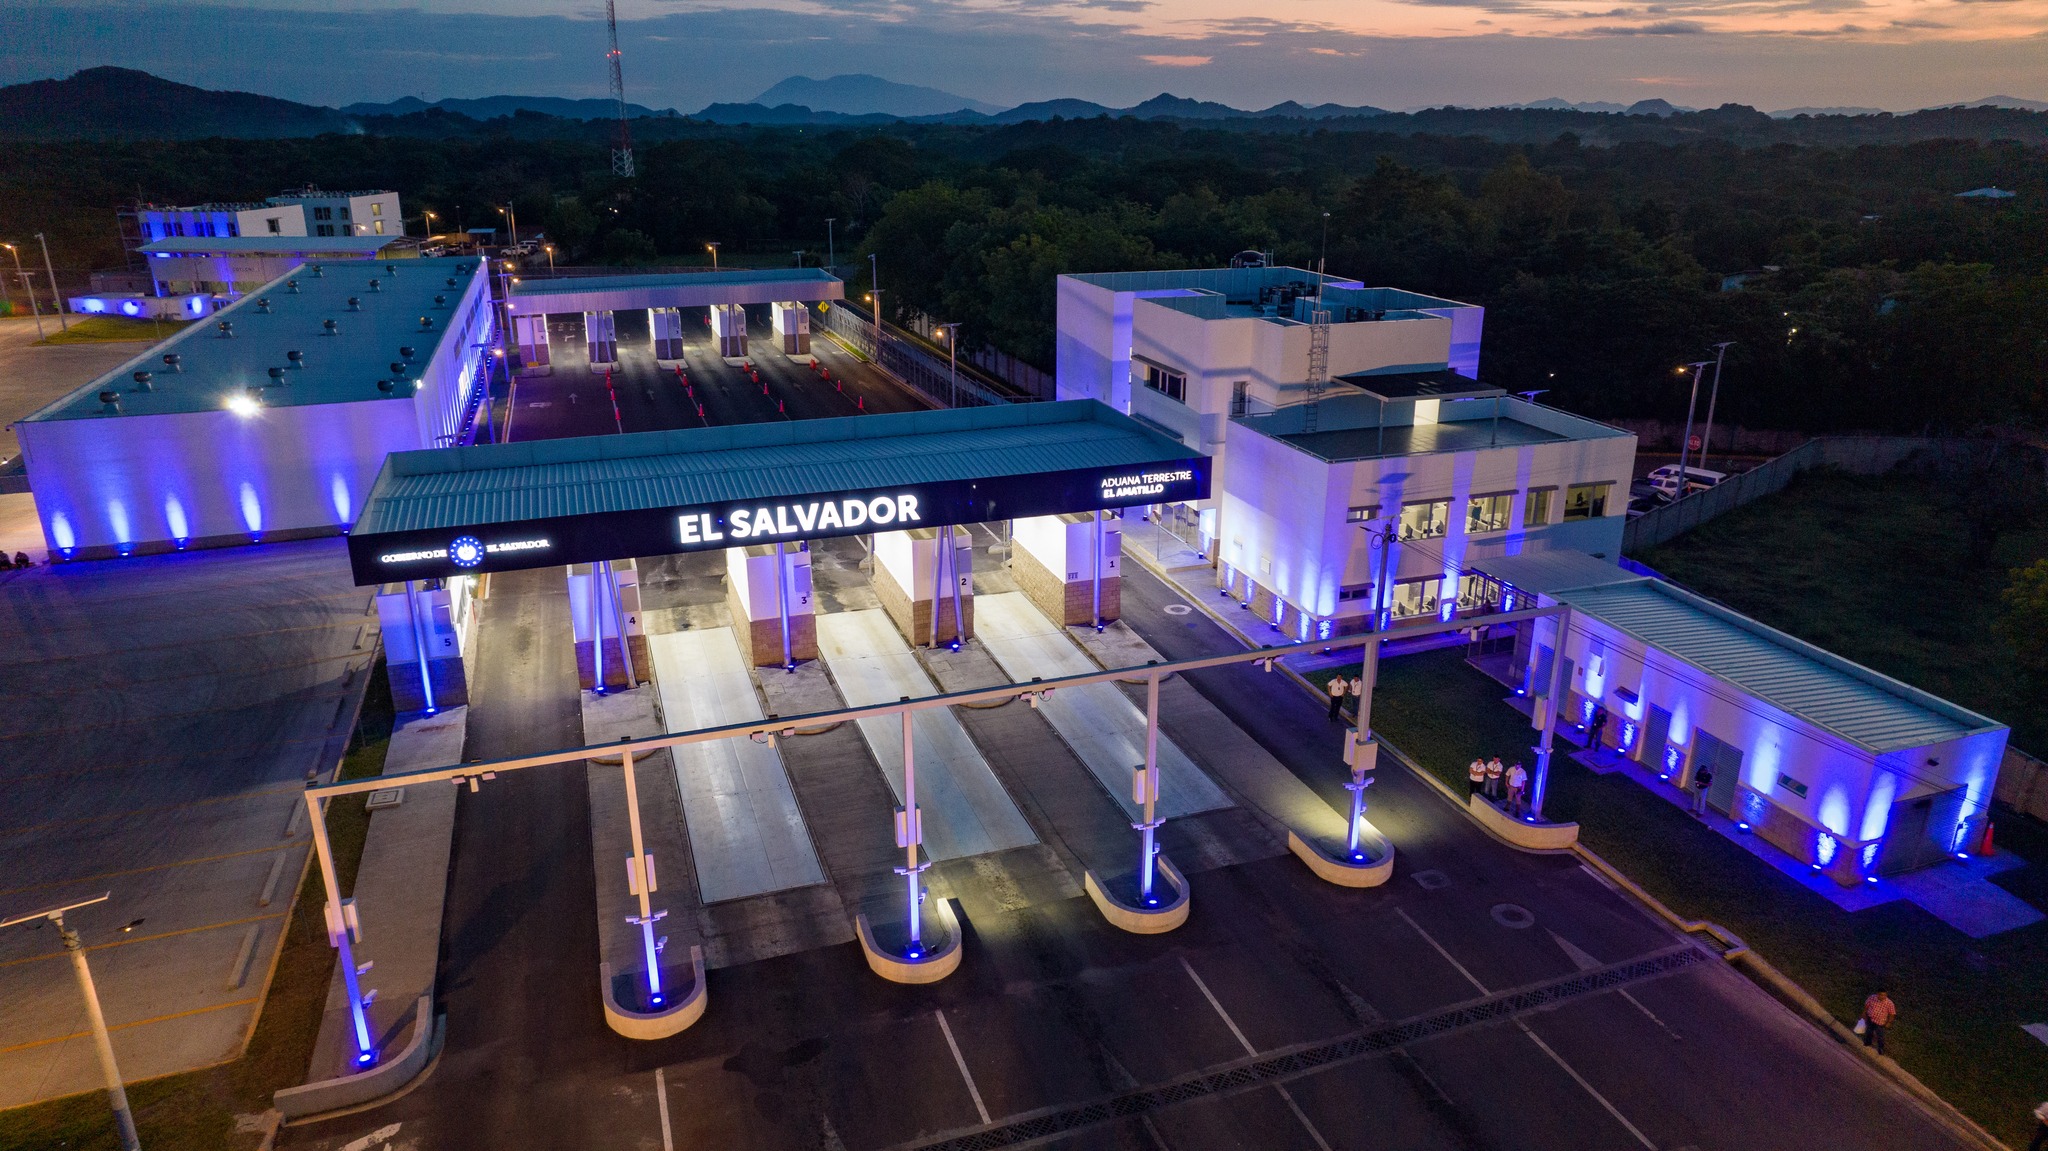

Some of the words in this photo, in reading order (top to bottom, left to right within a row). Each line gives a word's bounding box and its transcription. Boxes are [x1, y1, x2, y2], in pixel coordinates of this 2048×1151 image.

[1101, 475, 1141, 488] ADUANA
[1142, 470, 1192, 484] TERRESTRE
[1103, 489, 1115, 498] EL
[1116, 484, 1164, 497] AMATILLO
[678, 513, 723, 544] EL
[729, 494, 921, 538] SALVADOR
[381, 551, 433, 563] GOBIERNO
[434, 549, 447, 558] DE
[487, 544, 499, 552] EL
[499, 539, 550, 552] SALVADOR
[1109, 560, 1115, 568] 1
[961, 578, 967, 586] 2
[801, 596, 807, 604] 3
[629, 616, 636, 625] 4
[444, 638, 452, 647] 5
